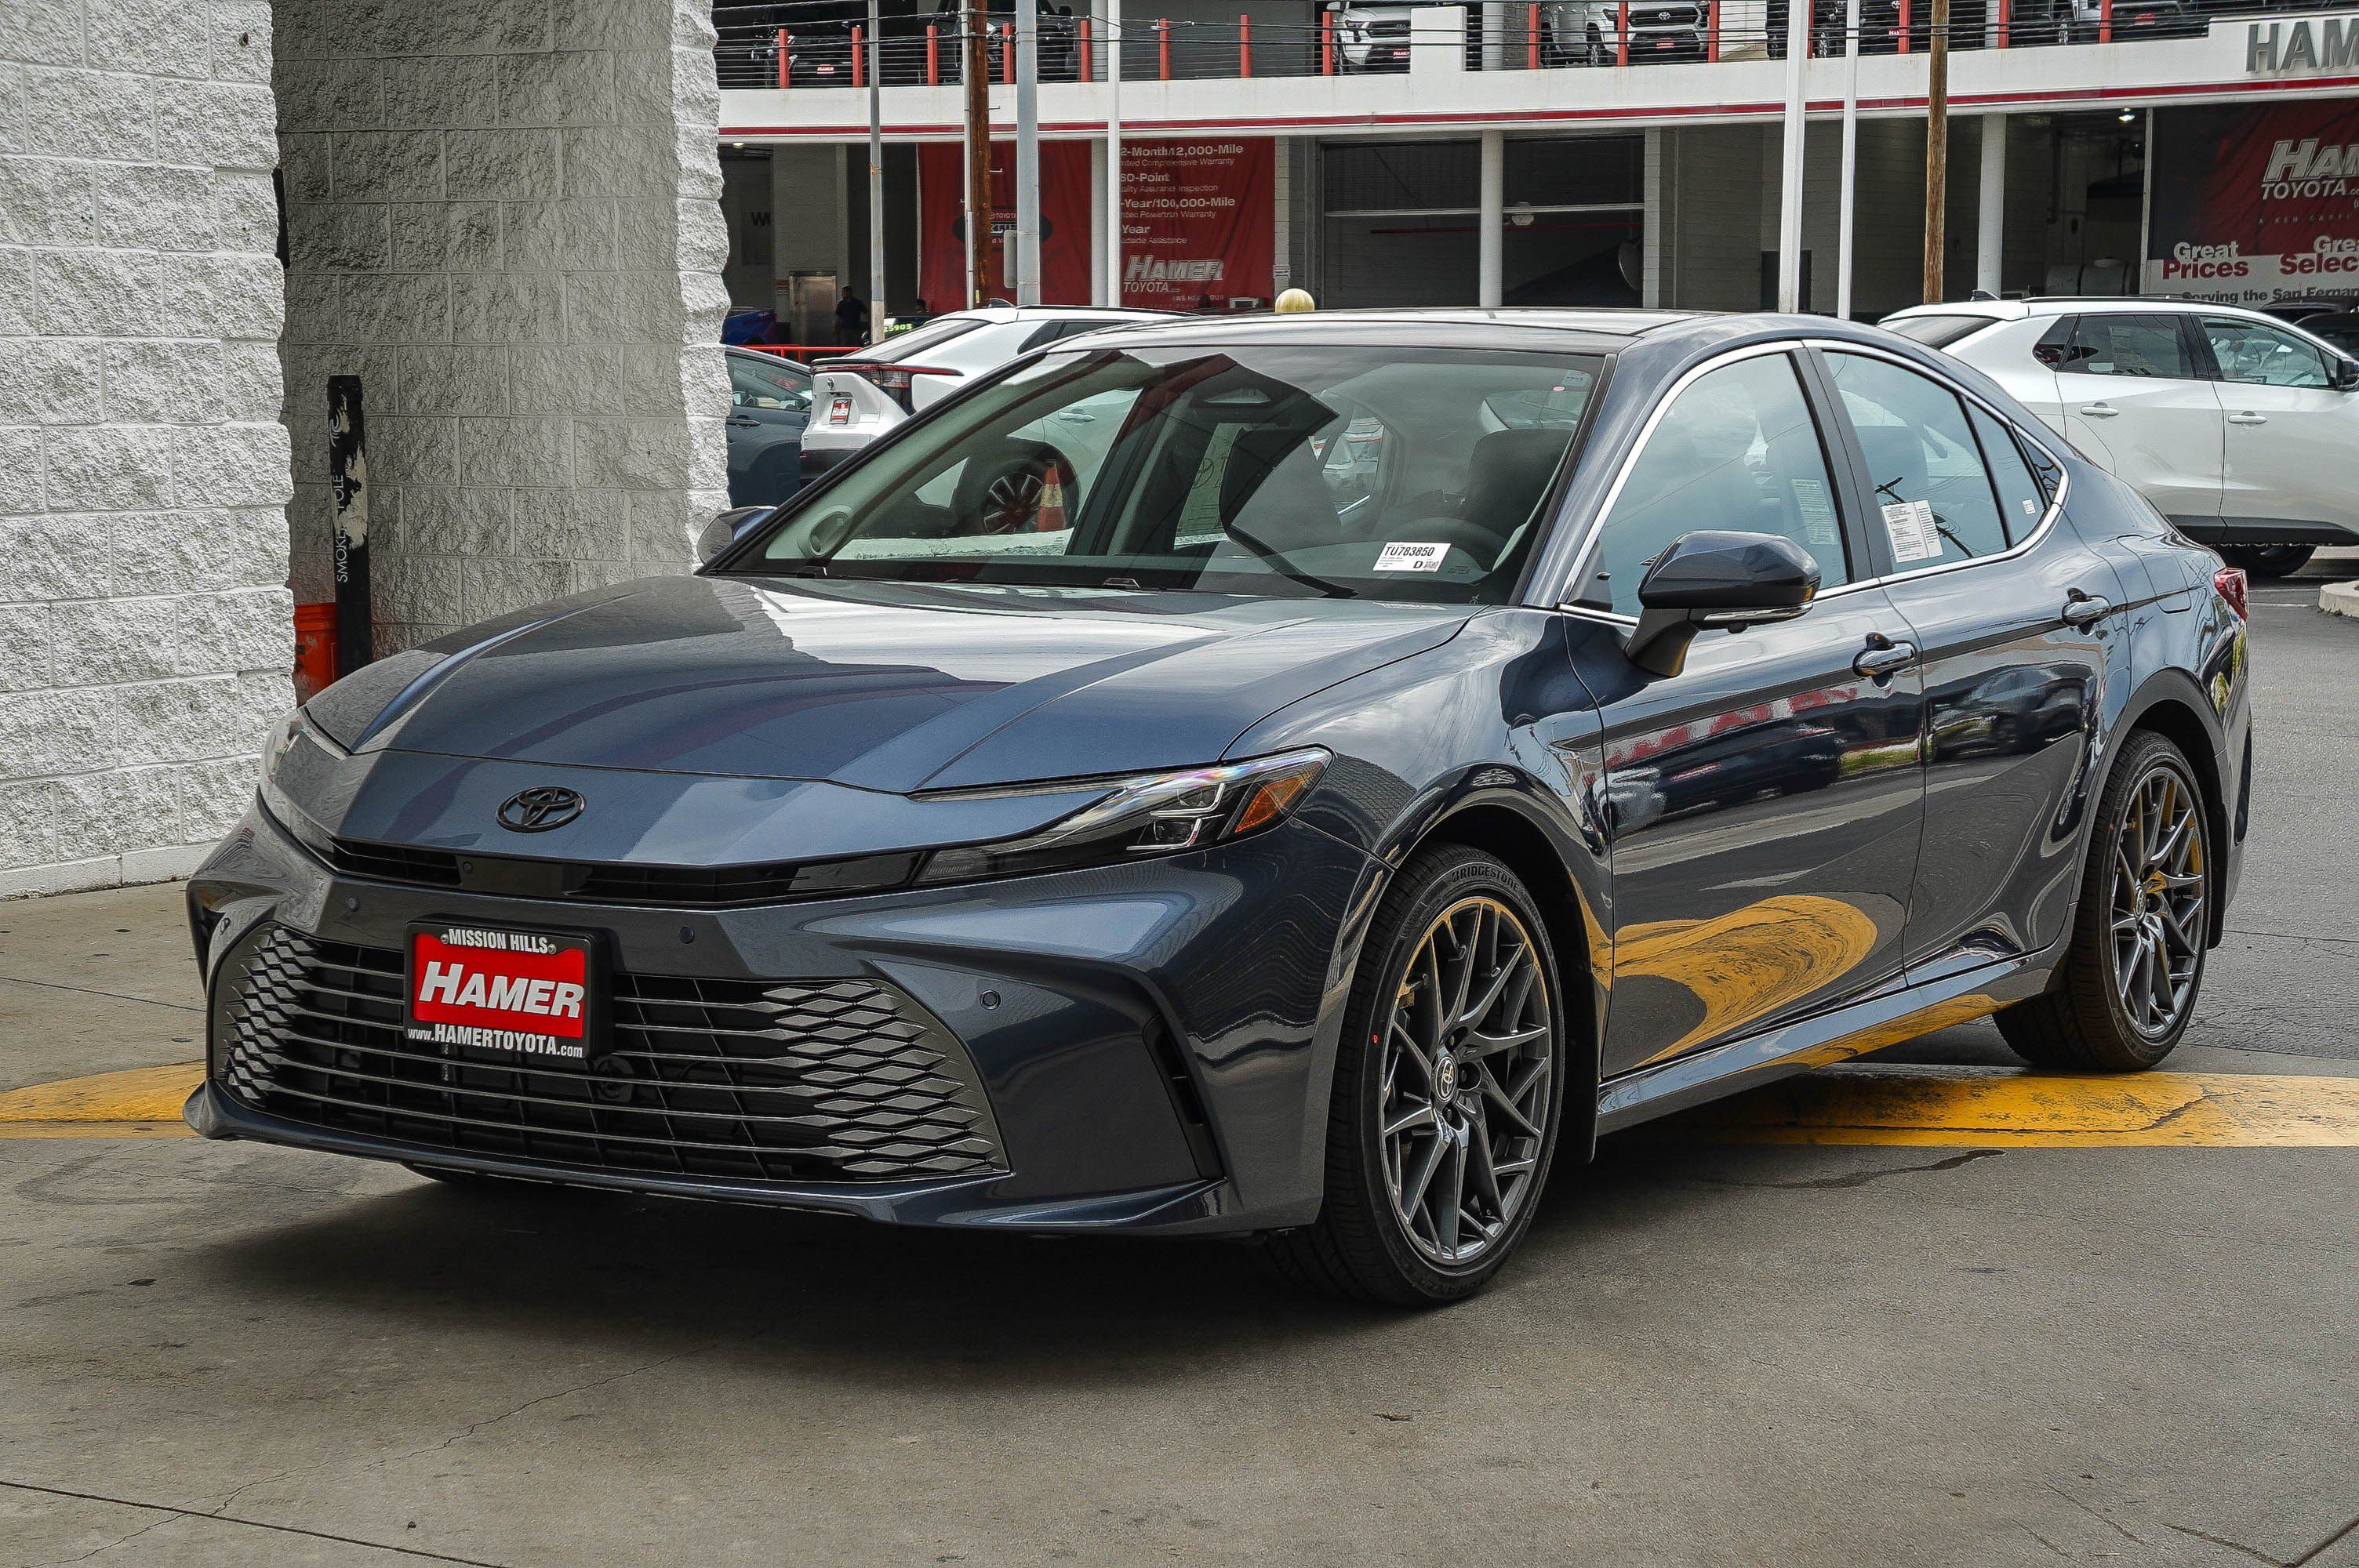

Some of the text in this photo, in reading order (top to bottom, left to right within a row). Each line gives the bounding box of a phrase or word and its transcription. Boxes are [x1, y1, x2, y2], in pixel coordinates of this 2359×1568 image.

[1178, 183, 1218, 193] Inspection
[1180, 210, 1216, 220] Warranty
[2173, 240, 2239, 262] Great
[2162, 257, 2249, 280] Prices
[2243, 288, 2268, 301] the
[336, 527, 347, 582] SMOKE
[1385, 546, 1434, 556] TU783850
[1451, 865, 1520, 892] BRIDGESTONE
[448, 928, 548, 954] MISSION HILLS
[419, 961, 584, 1018] HAMER
[408, 1024, 583, 1058] www.HAMERTOYOTA.com
